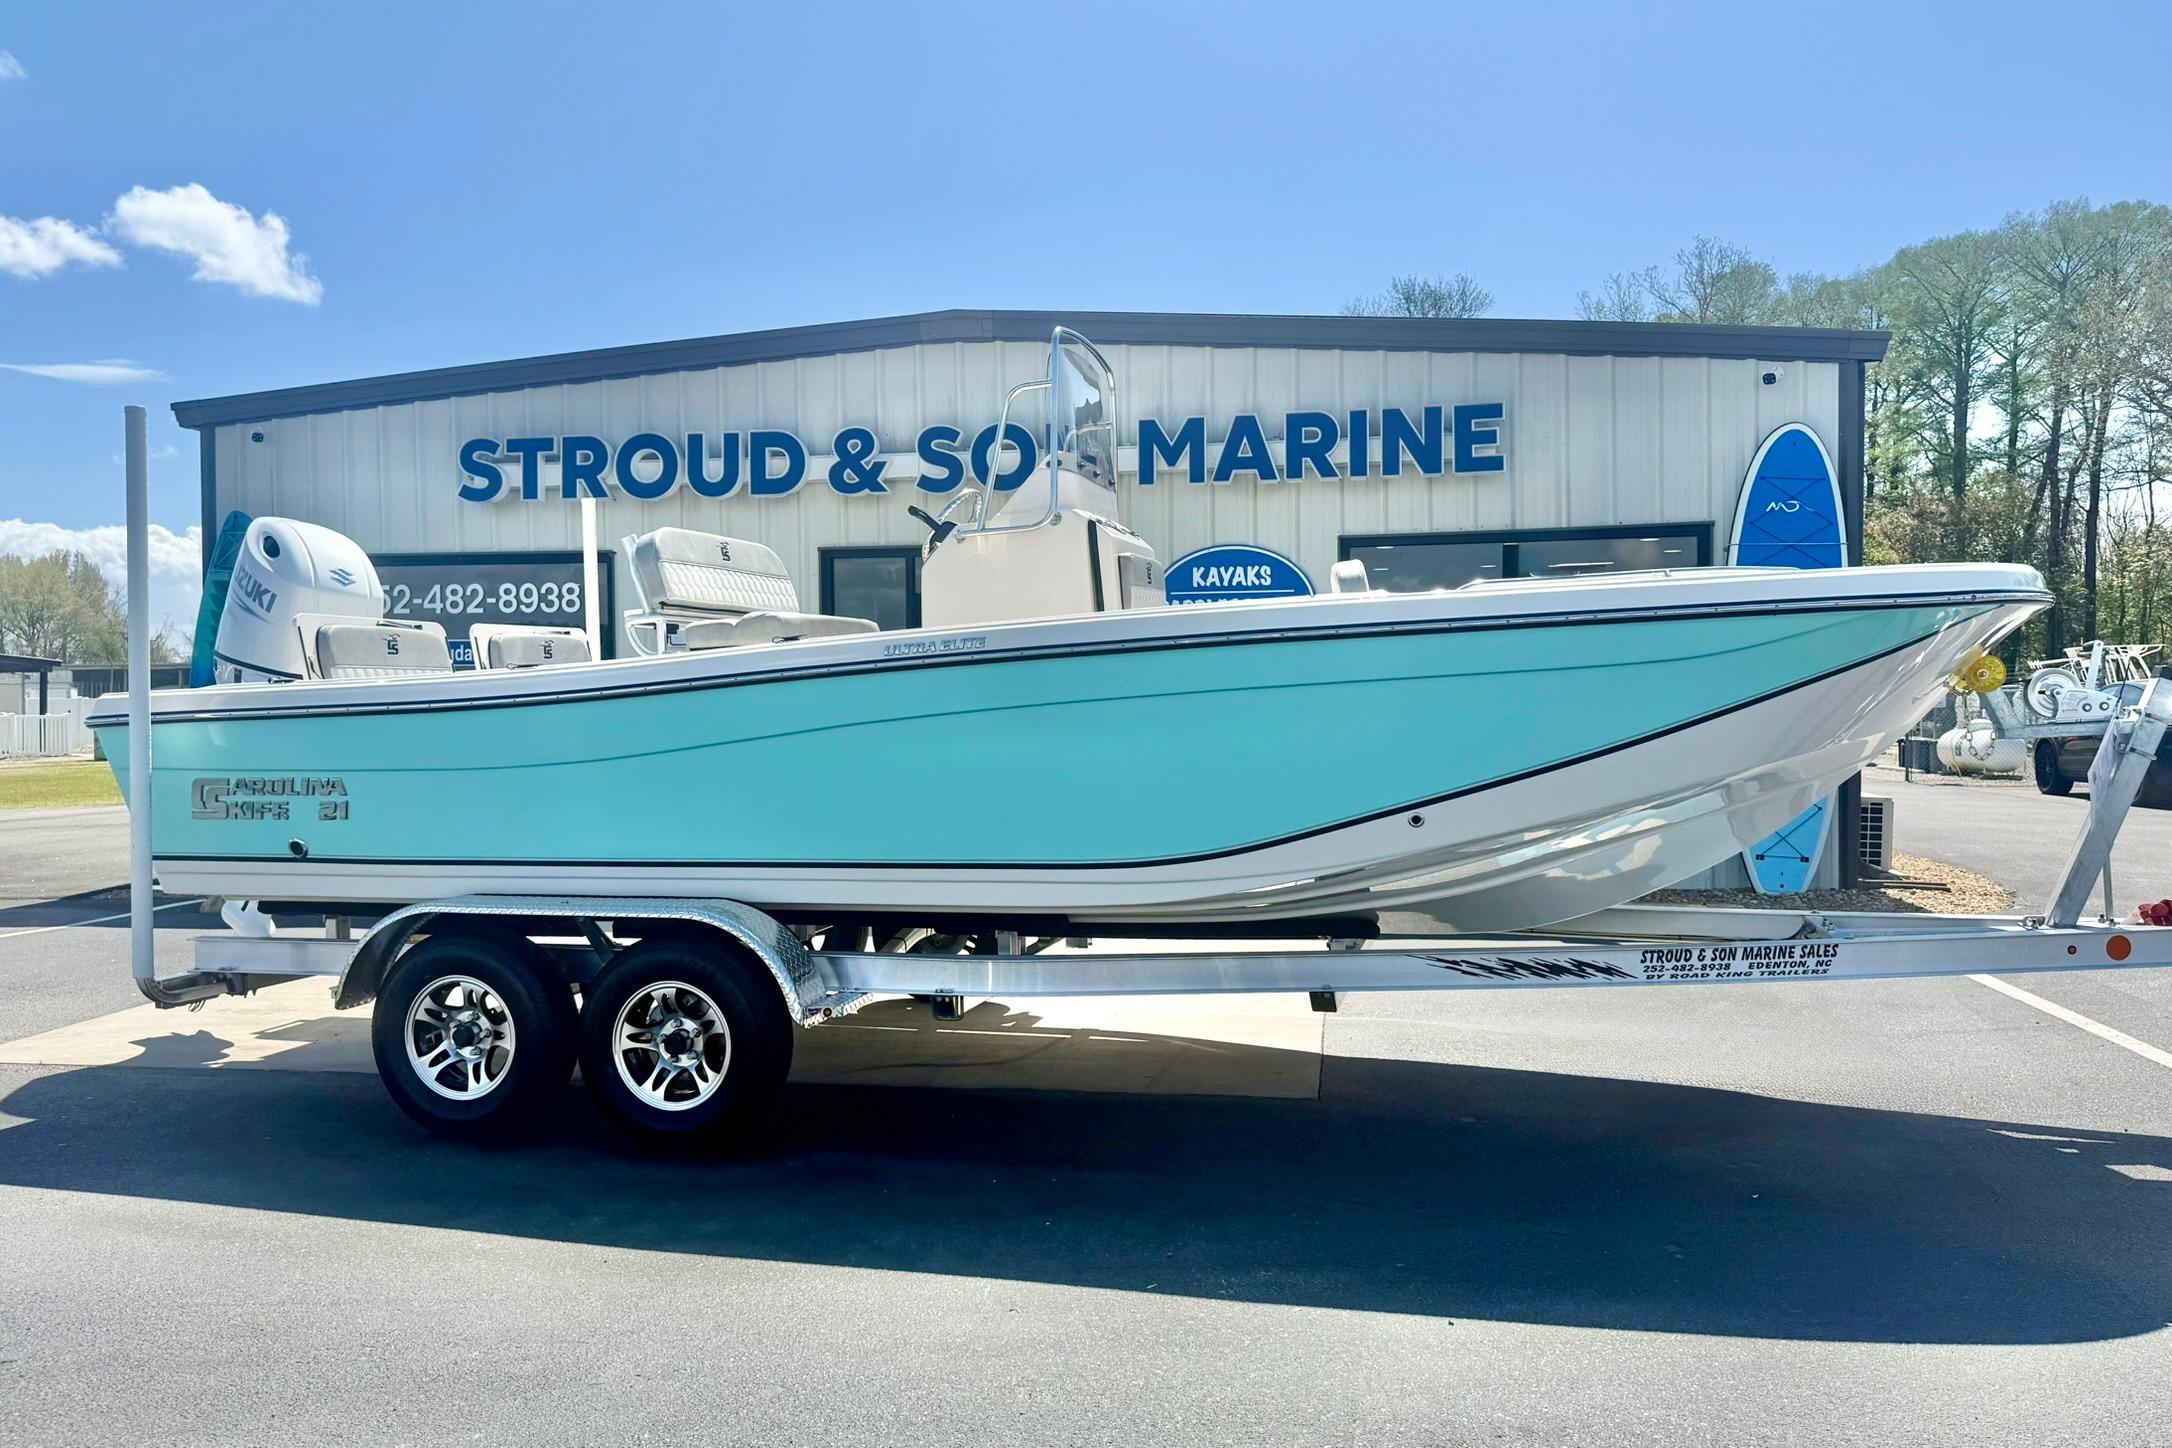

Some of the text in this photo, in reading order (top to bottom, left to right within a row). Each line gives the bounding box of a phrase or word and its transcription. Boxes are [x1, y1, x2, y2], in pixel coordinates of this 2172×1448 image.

[457, 430, 808, 502] STROUD
[828, 426, 889, 496] &
[1138, 402, 1505, 485] MARINE
[1193, 565, 1272, 588] KAYAKS
[884, 637, 986, 656] ULTRA ELITE
[192, 777, 348, 809] CAROLINA
[318, 801, 349, 820] 21
[1641, 944, 1839, 964] STROUD & SON MARINE SALES
[1643, 960, 1833, 973] 252-482-8938 EDENTON, NC
[1759, 968, 1830, 977] TRAILERS
